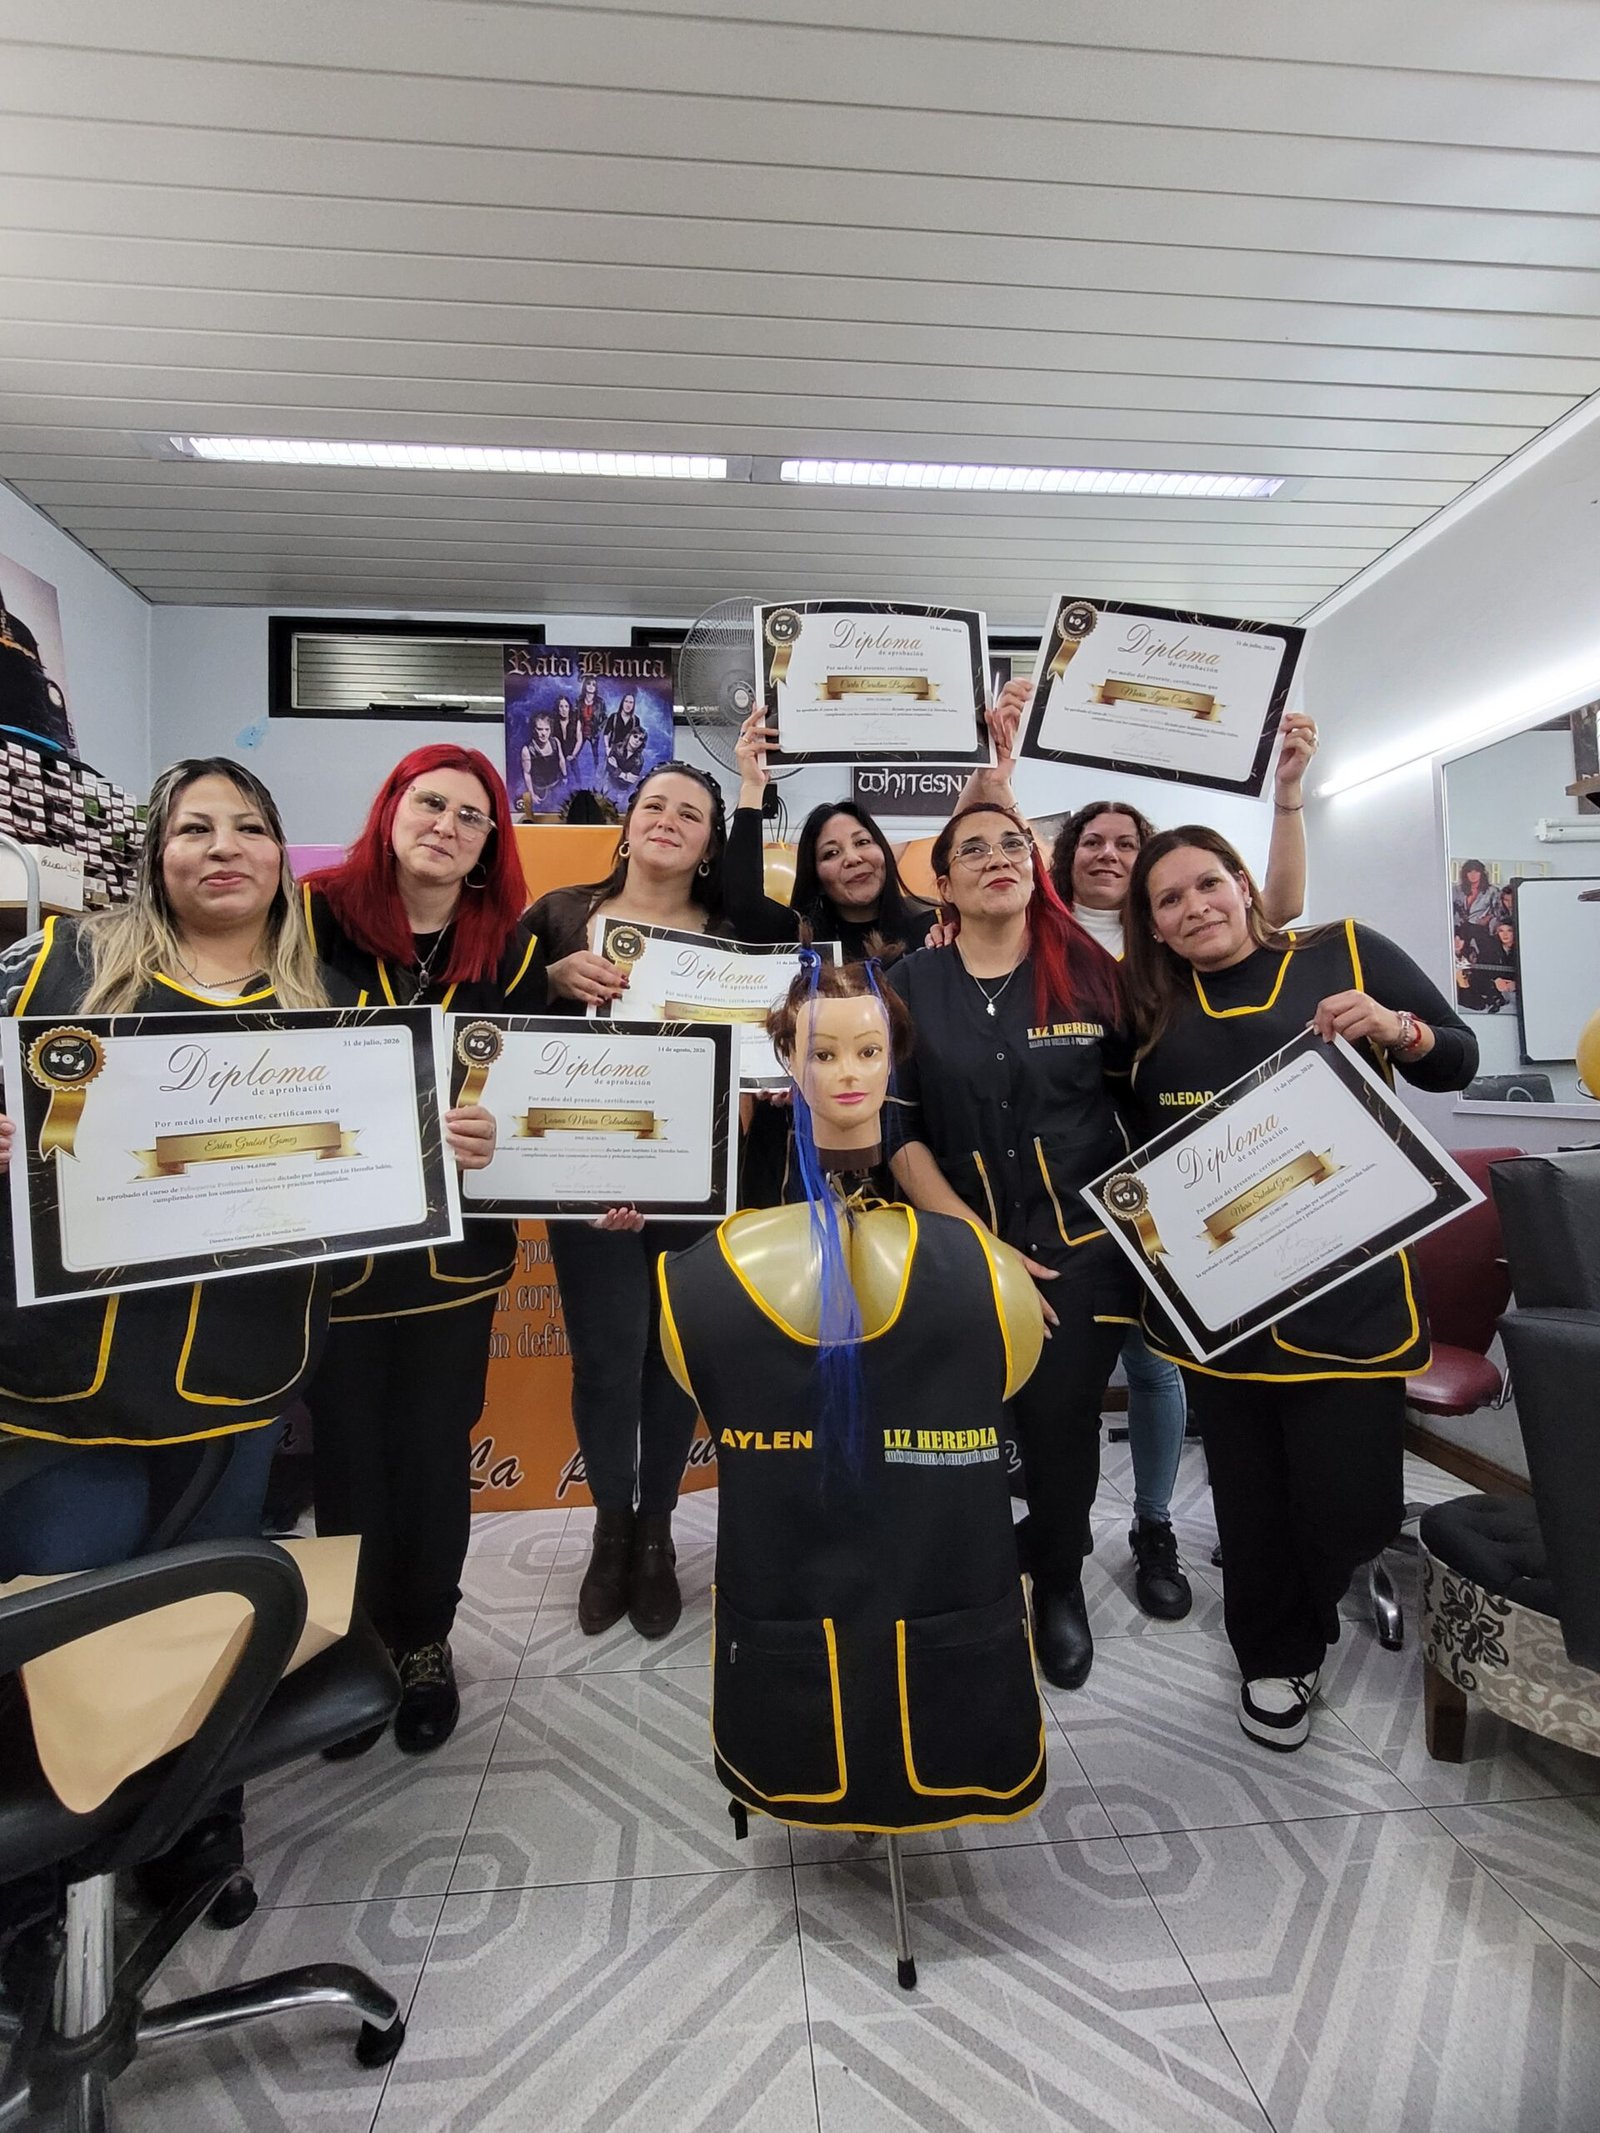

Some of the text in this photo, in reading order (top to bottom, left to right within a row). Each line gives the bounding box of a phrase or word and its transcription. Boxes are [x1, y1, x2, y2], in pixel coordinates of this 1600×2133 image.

[829, 618, 922, 659] Diploma
[1117, 623, 1221, 667] Diploma
[508, 648, 665, 681] Rata Blanca
[858, 768, 972, 799] WHITESN
[670, 950, 767, 989] Diploma
[1027, 1022, 1104, 1040] LIZ HEREDIA
[159, 1043, 330, 1105] Diploma
[533, 1040, 651, 1088] Diploma
[251, 1083, 332, 1097] de aprobación
[606, 1078, 651, 1087] aprobación
[1159, 1090, 1214, 1106] SOLEDAD
[175, 1117, 204, 1127] medio
[207, 1115, 222, 1124] del
[224, 1112, 267, 1124] presente,
[268, 1106, 322, 1119] certificamos
[324, 1107, 340, 1117] que
[1176, 1114, 1280, 1190] Diploma
[1237, 1125, 1289, 1163] de aprobación
[107, 1191, 140, 1202] aprobado
[1206, 1194, 1224, 1208] medio
[1223, 1186, 1234, 1196] del
[517, 1285, 562, 1318] corp
[720, 1427, 814, 1450] AYLEN
[883, 1426, 999, 1450] LIZ HEREDIA
